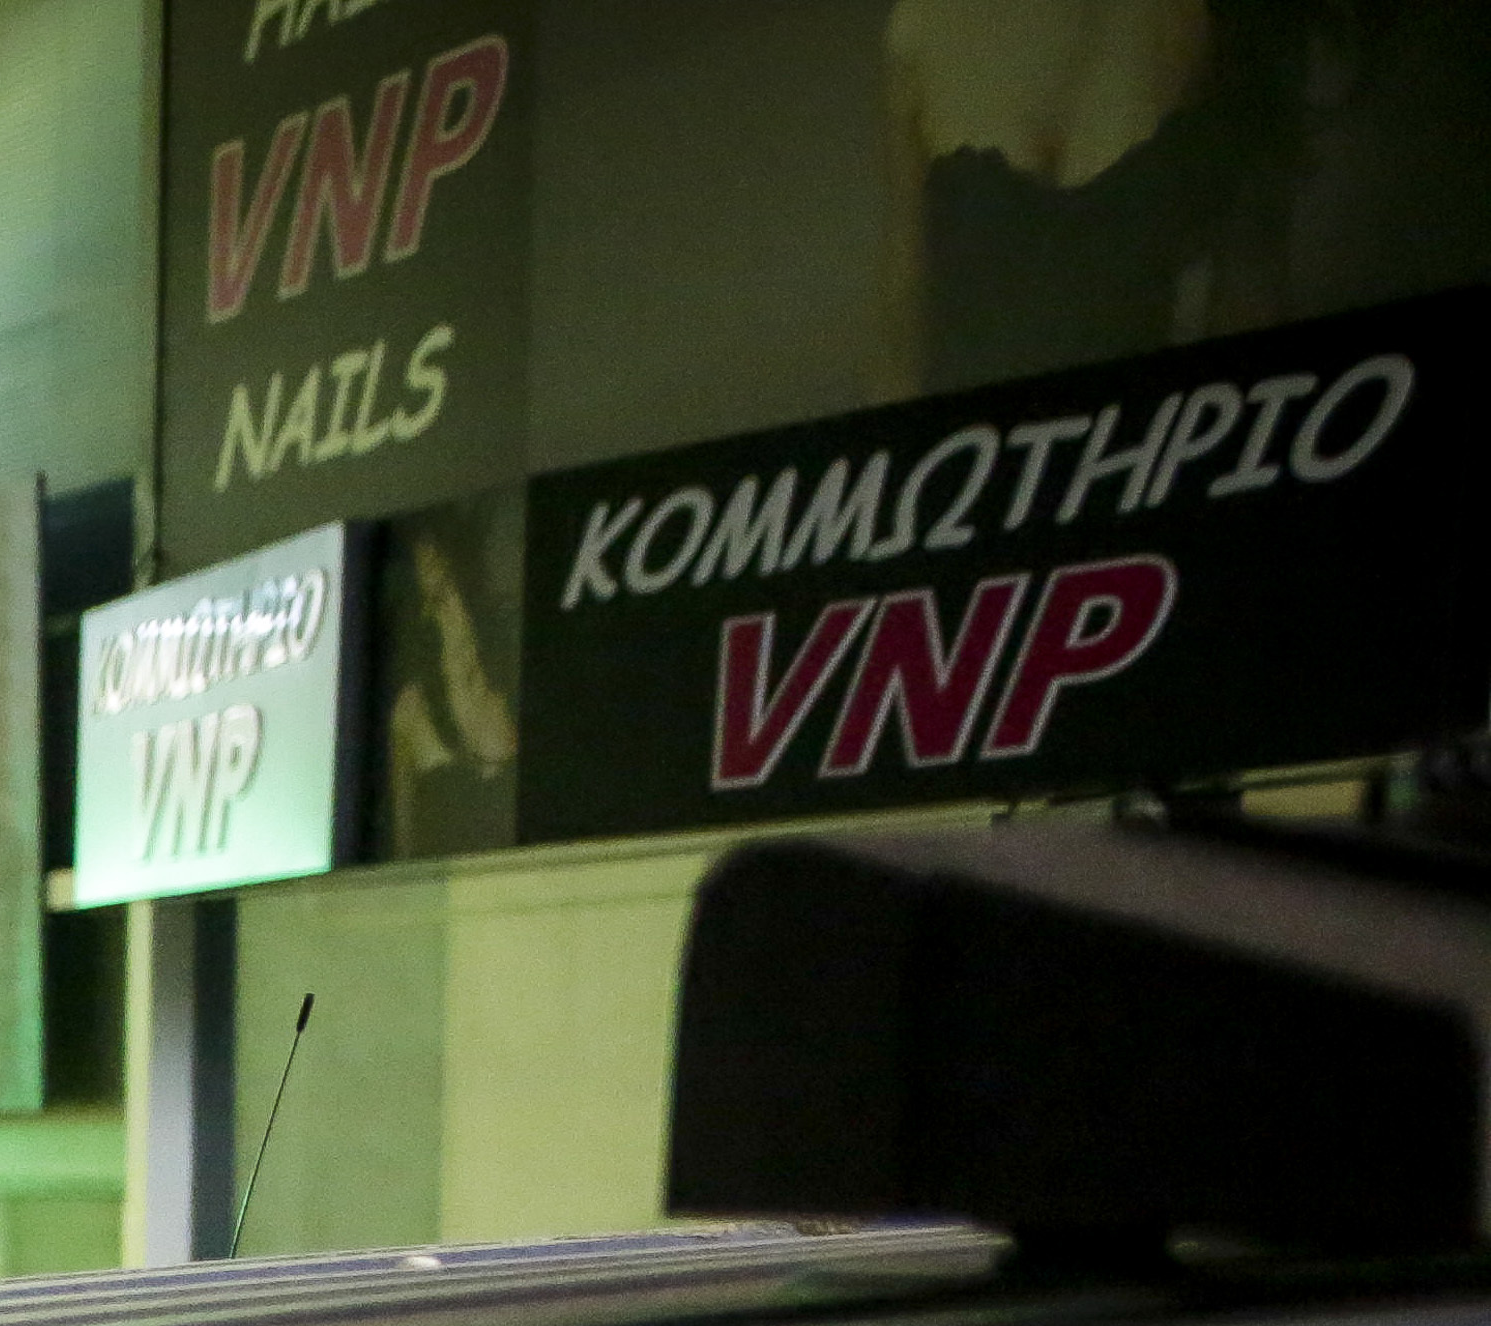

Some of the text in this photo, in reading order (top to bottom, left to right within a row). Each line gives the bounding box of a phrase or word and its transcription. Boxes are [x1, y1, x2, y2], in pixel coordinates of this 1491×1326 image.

[207, 32, 510, 324] VNP
[214, 323, 455, 494] NAILS
[561, 354, 1415, 611] ΚΟΜΜΩΤΗΡΙΟ
[129, 703, 264, 866] VNP
[711, 552, 1179, 791] VNP
